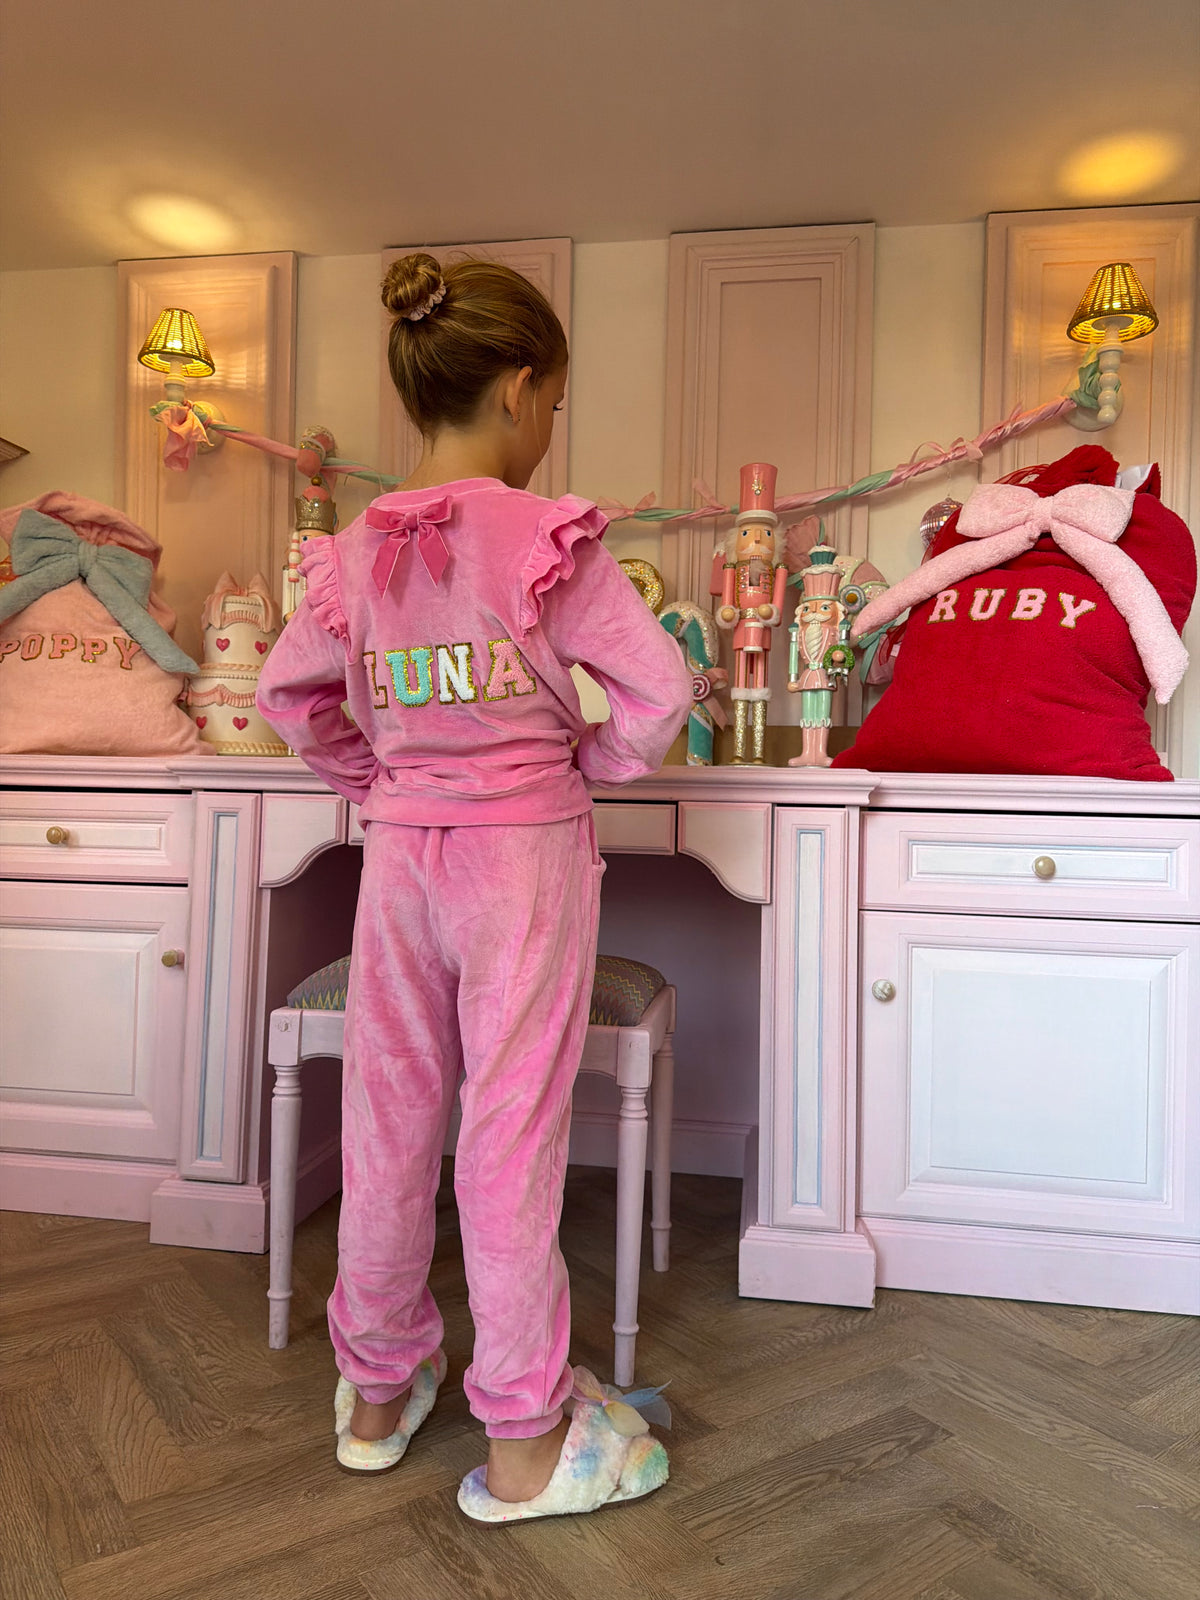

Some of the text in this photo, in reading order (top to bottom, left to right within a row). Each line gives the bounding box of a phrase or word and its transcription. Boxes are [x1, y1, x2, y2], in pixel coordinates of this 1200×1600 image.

[927, 587, 1097, 629] RUBY
[0, 633, 141, 671] POPPY
[362, 638, 537, 710] LUNA
